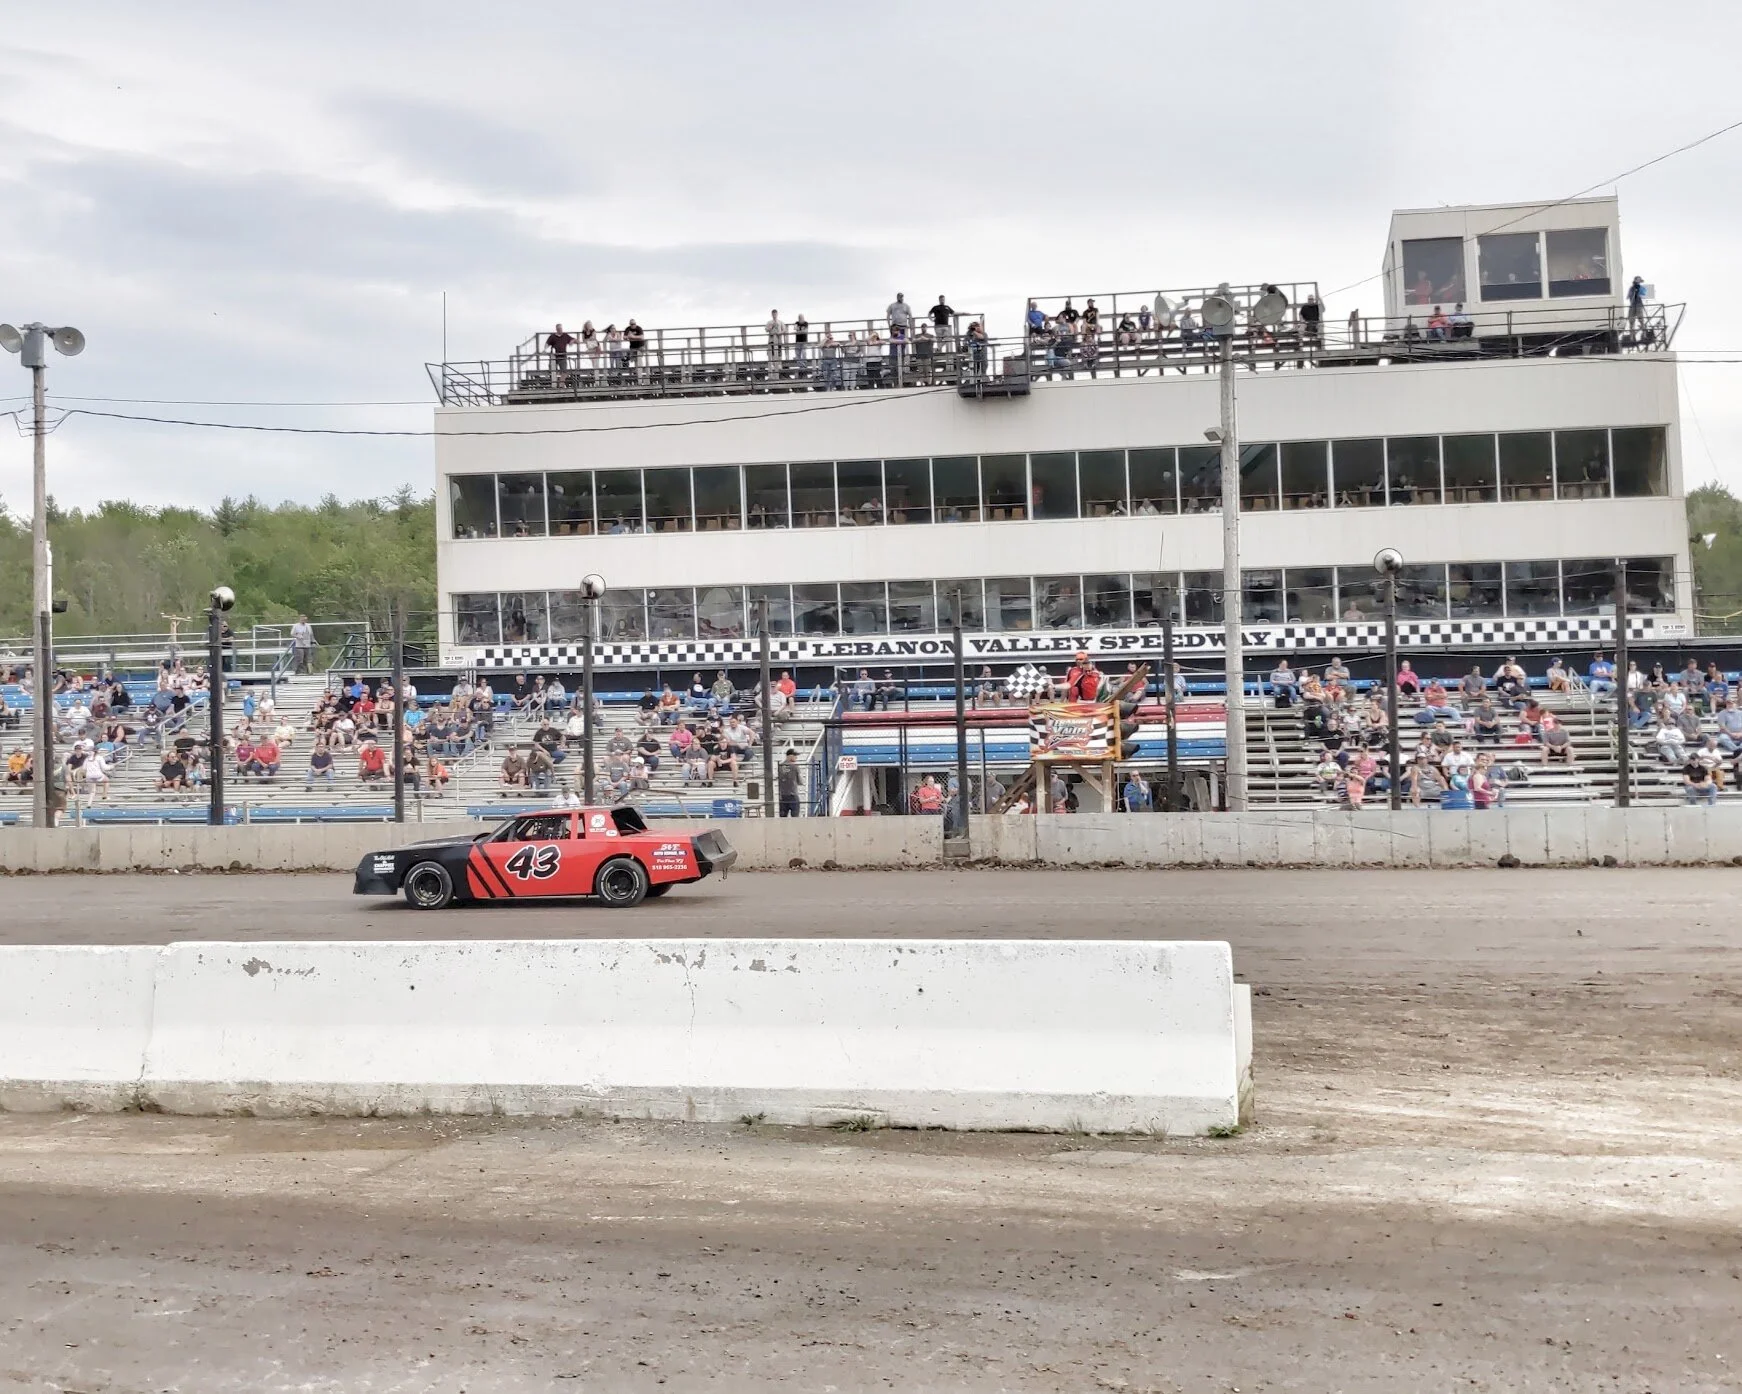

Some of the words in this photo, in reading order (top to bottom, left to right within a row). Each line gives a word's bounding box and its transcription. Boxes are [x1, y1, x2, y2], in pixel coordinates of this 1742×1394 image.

[812, 641, 955, 657] LEBANON
[969, 637, 1092, 653] VALLEY
[505, 845, 561, 880] 43
